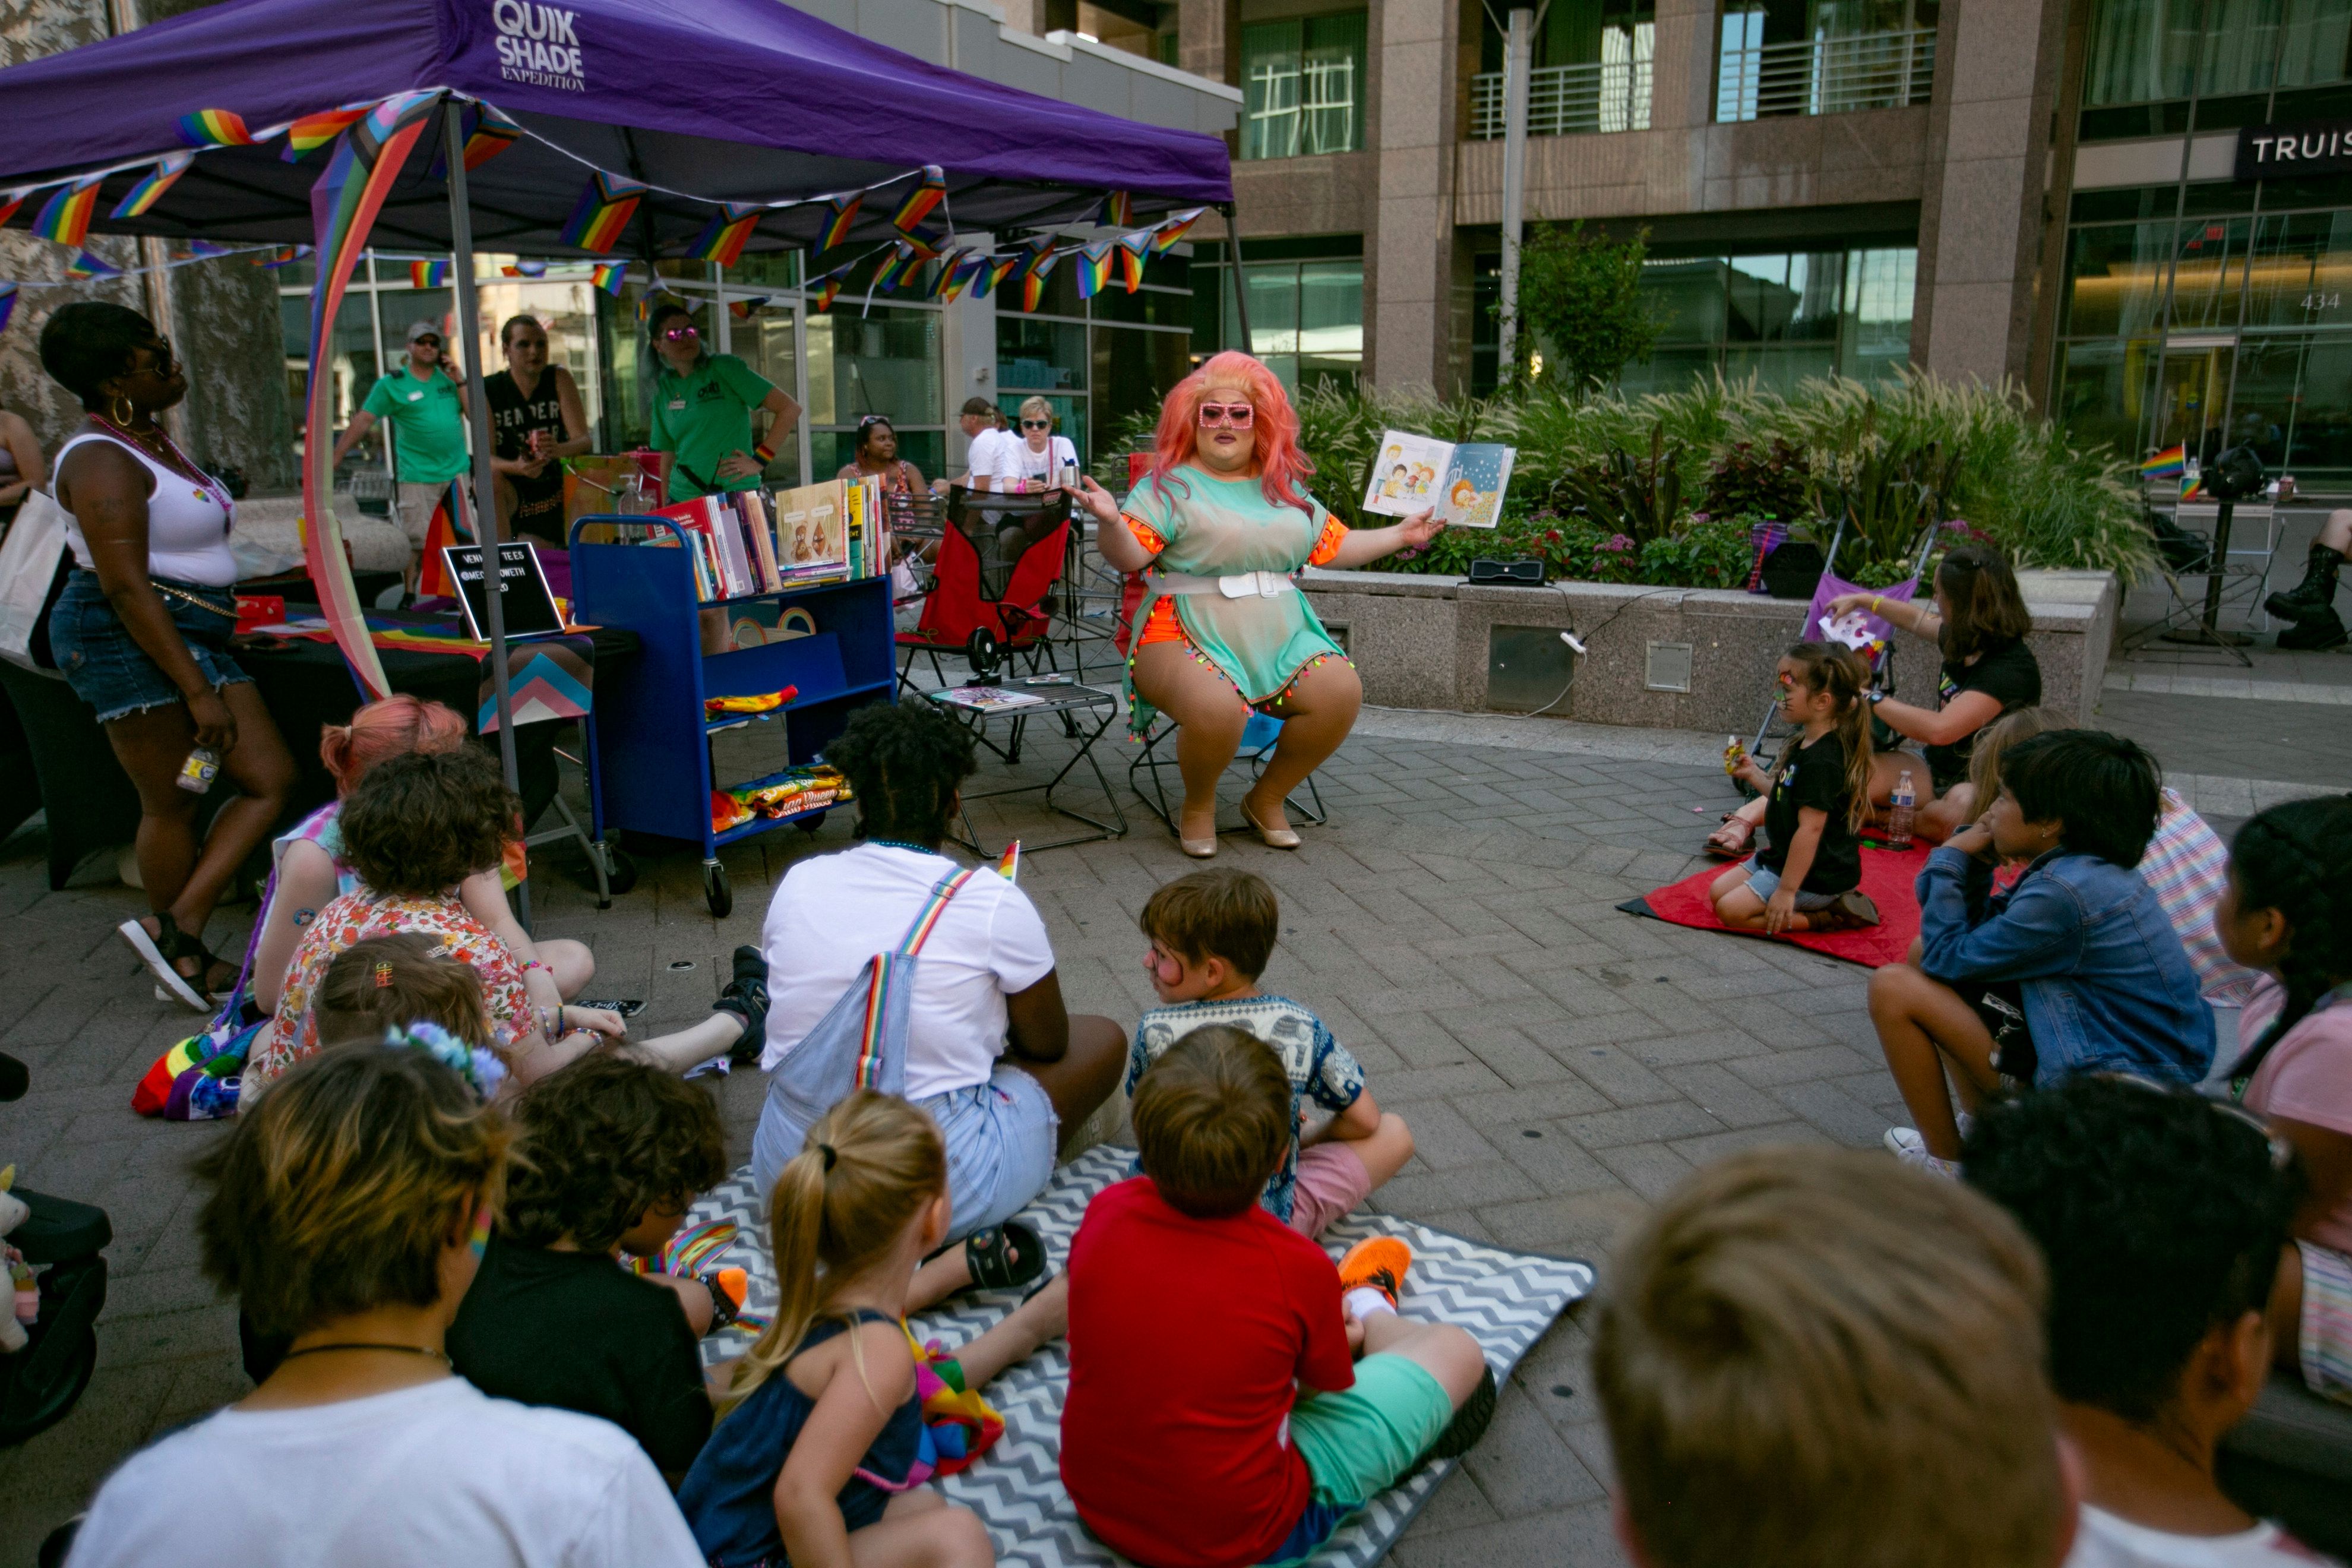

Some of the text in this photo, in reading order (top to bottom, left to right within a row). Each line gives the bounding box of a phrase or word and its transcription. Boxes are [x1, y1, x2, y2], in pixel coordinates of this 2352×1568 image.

[494, 0, 580, 46] QUIK
[495, 36, 584, 78] SHADE
[501, 67, 585, 92] EXPEDITION
[2300, 293, 2341, 310] 434
